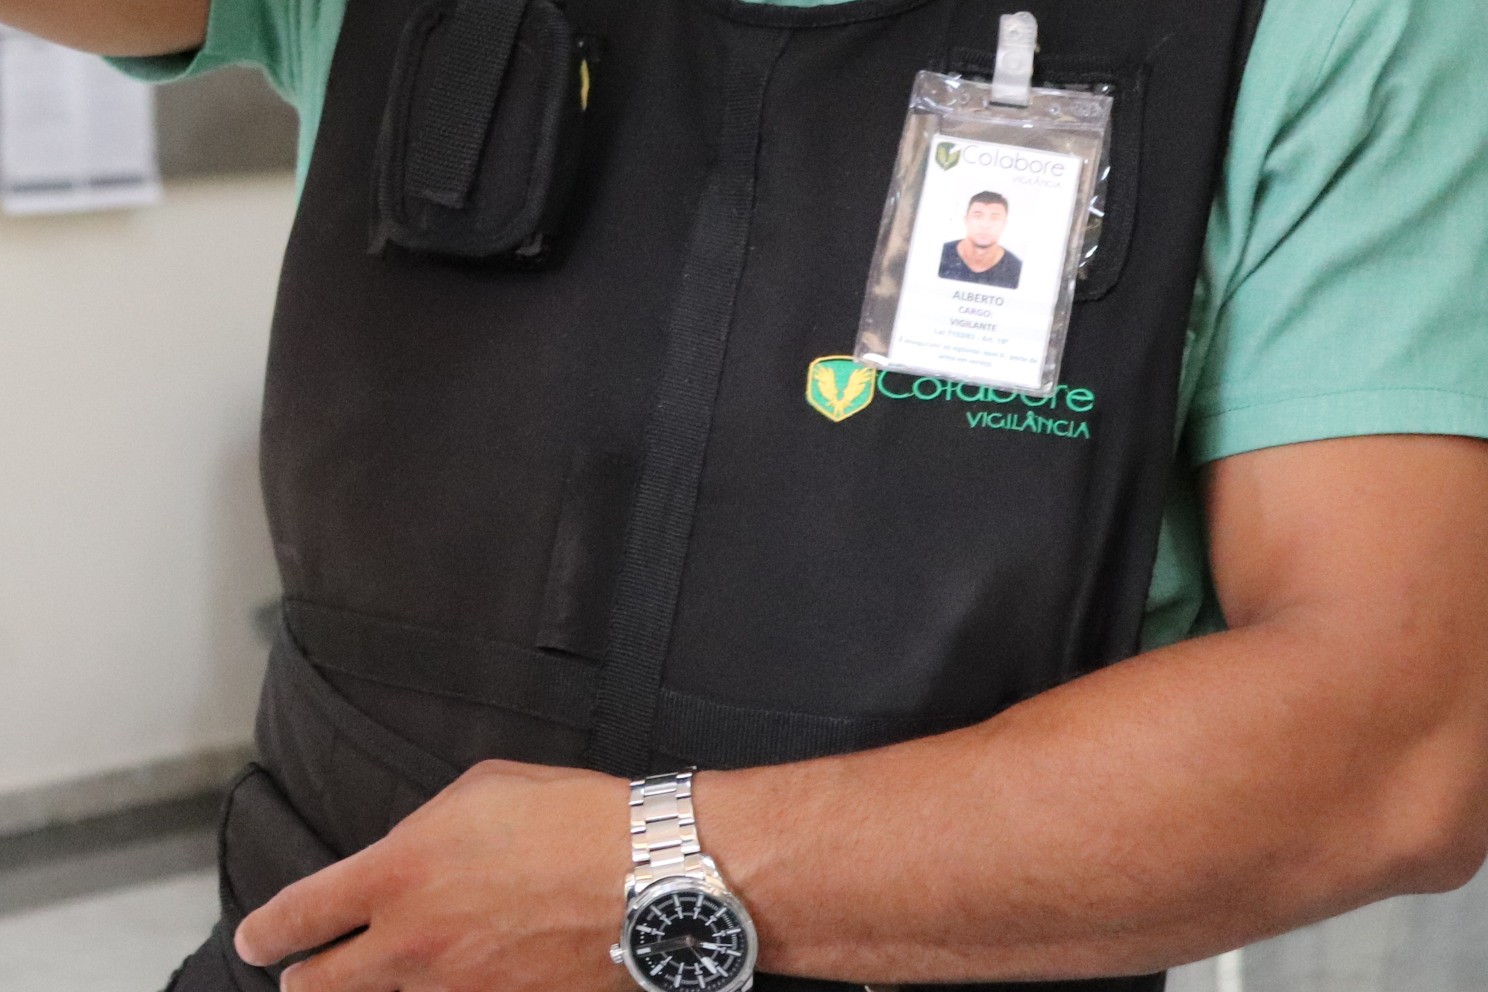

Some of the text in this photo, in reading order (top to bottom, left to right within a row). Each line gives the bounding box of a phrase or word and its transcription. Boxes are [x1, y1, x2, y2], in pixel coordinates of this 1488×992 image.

[962, 144, 1065, 177] Colabore
[952, 290, 1005, 307] ALBERTO
[949, 318, 998, 333] VIGILANTE
[965, 410, 1091, 440] VIGILÂNCIA
